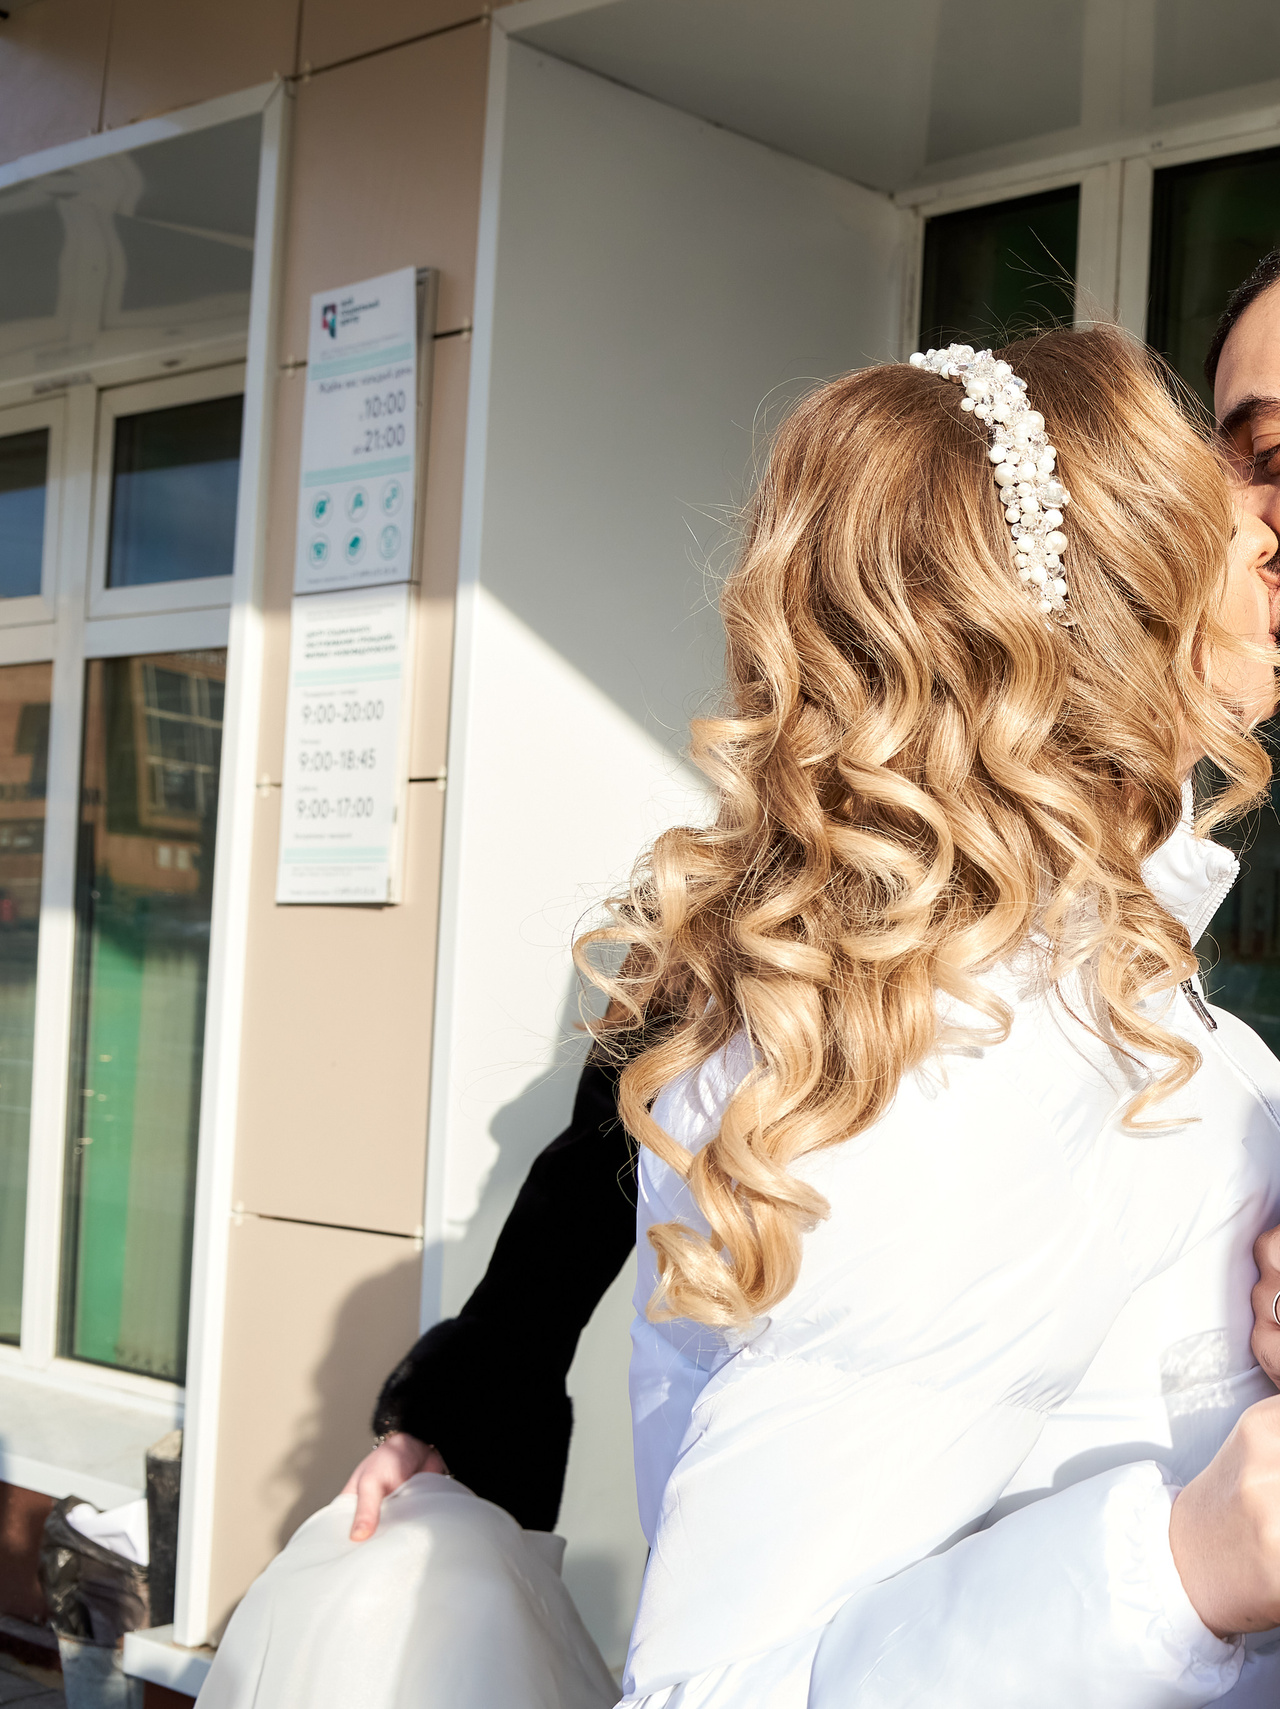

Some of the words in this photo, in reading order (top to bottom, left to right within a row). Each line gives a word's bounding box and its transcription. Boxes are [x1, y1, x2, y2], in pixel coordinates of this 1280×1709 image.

[365, 389, 406, 420] 10:00
[364, 422, 406, 453] 21:00
[303, 699, 384, 724] 9:00-20:00
[298, 747, 376, 771] 9:00-18:45
[296, 796, 374, 819] 9:00-17:00
